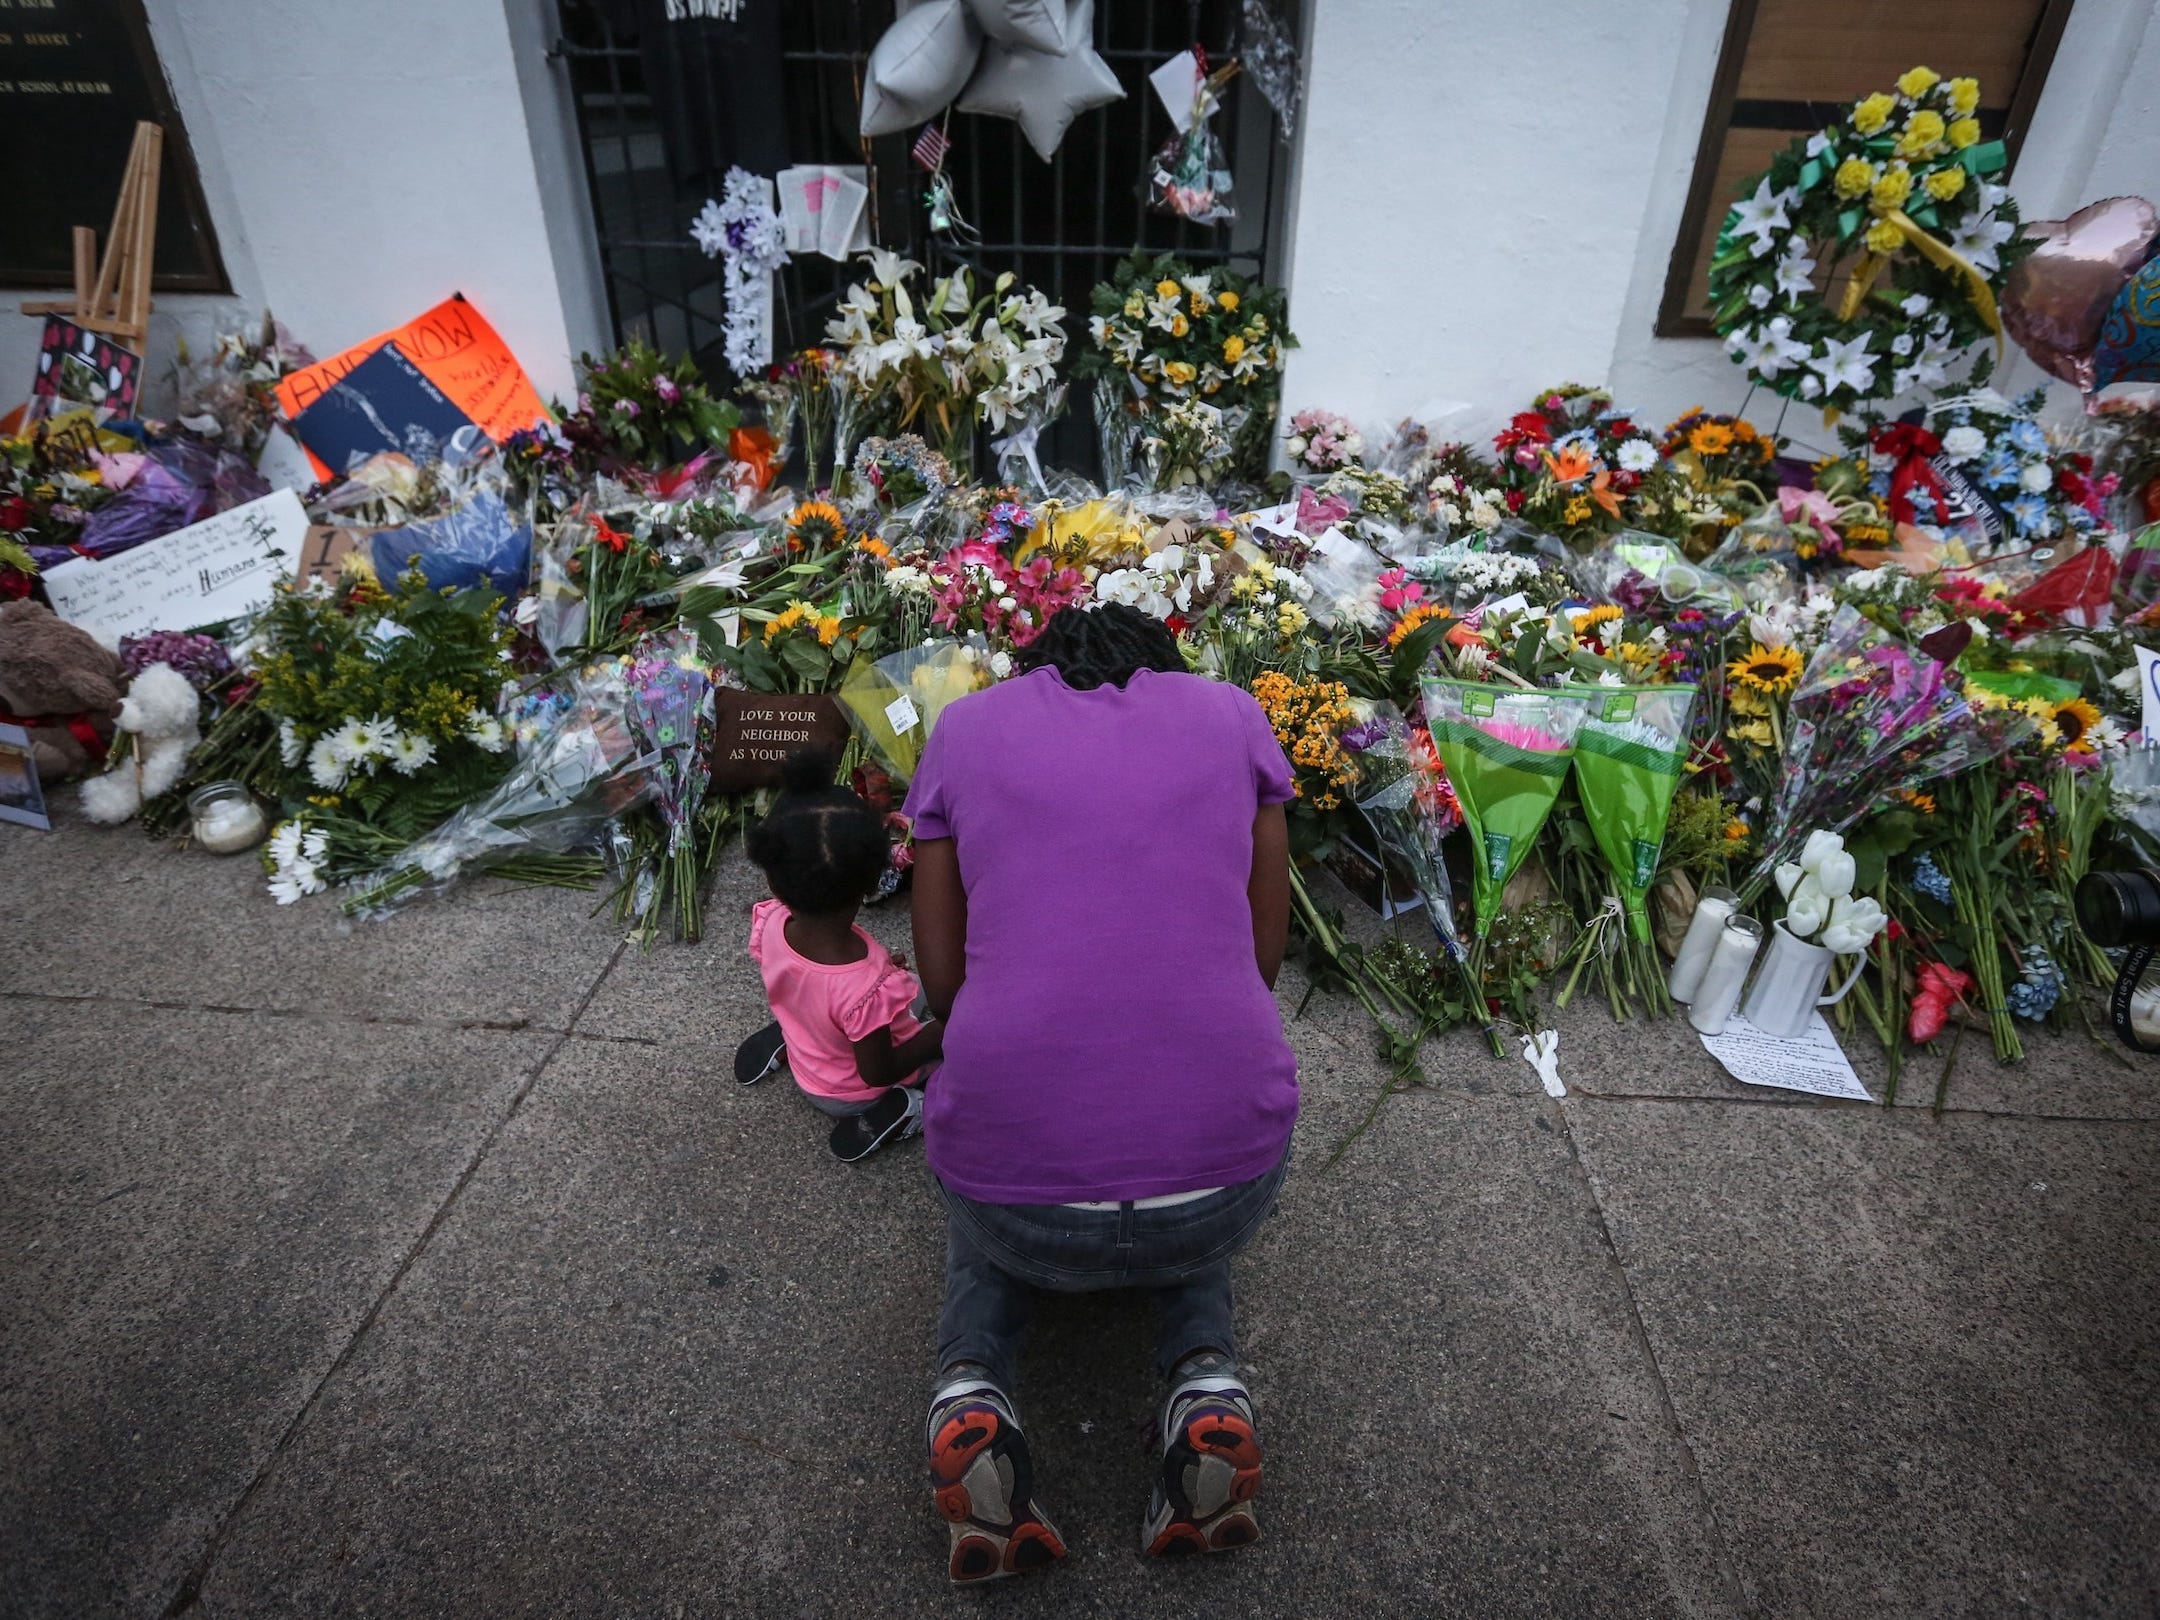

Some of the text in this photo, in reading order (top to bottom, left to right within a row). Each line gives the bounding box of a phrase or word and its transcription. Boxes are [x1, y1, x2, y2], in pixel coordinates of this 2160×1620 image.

[391, 306, 475, 359] NOW
[1943, 491, 1974, 519] 27
[740, 710, 816, 722] LOVE YOUR
[741, 729, 809, 742] NEIGHBOR
[729, 748, 745, 760] AS
